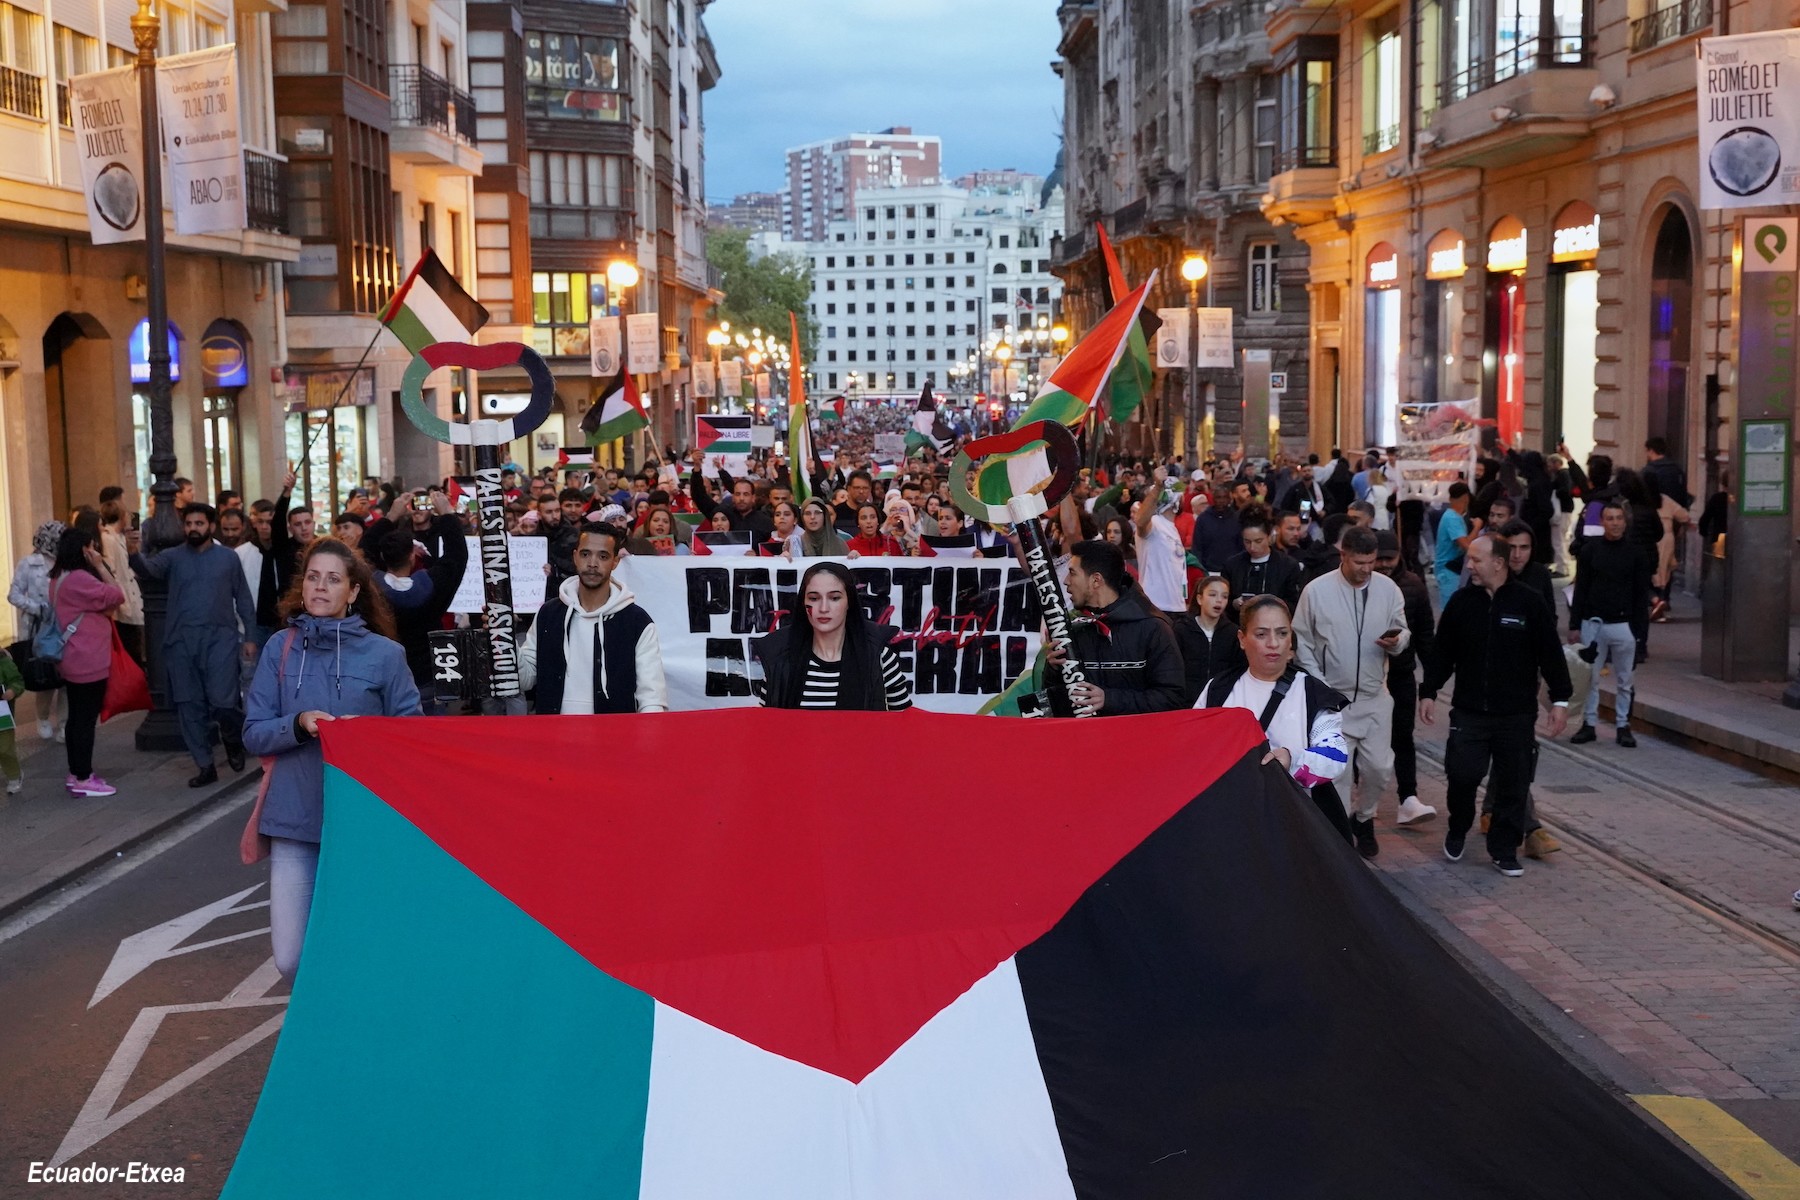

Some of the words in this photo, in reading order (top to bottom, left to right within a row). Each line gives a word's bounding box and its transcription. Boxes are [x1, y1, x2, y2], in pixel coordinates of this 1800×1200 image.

[1708, 60, 1759, 94] ROMÉO
[1763, 62, 1780, 89] ET
[116, 99, 125, 126] ET
[1708, 92, 1774, 123] JULIETTE
[86, 129, 128, 159] JULIETTE
[190, 177, 223, 205] ABAO
[1553, 214, 1600, 256] arenal
[1766, 275, 1793, 412] Abando
[475, 467, 509, 586] PALESTINA
[685, 566, 1043, 634] PALSTINA
[1025, 545, 1072, 651] PALESTINA
[433, 642, 464, 683] 194
[486, 601, 521, 697] ASKATU!!!
